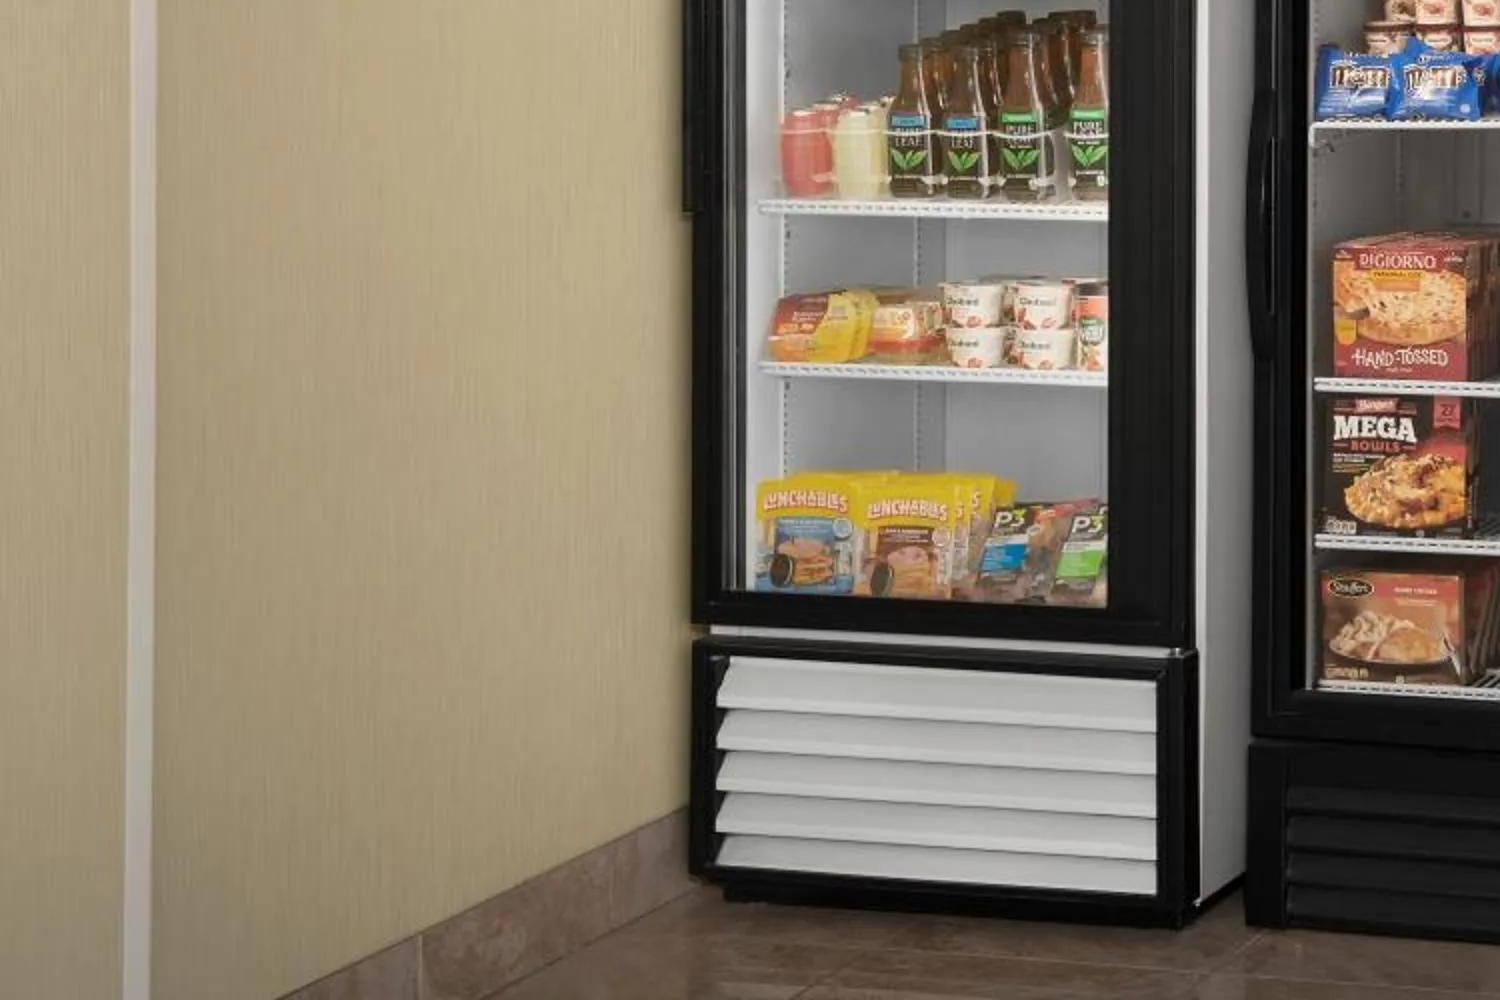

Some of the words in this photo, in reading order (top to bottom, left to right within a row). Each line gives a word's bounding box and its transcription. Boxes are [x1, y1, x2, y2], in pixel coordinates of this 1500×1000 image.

[1351, 345, 1449, 370] HAND-TOSSED
[1333, 415, 1418, 443] MEGA
[1350, 440, 1401, 453] BOWLS
[763, 488, 849, 514] LUNCHABLES
[867, 498, 949, 522] LUNCHABLES
[994, 510, 1026, 531] P3
[1072, 514, 1105, 534] P3
